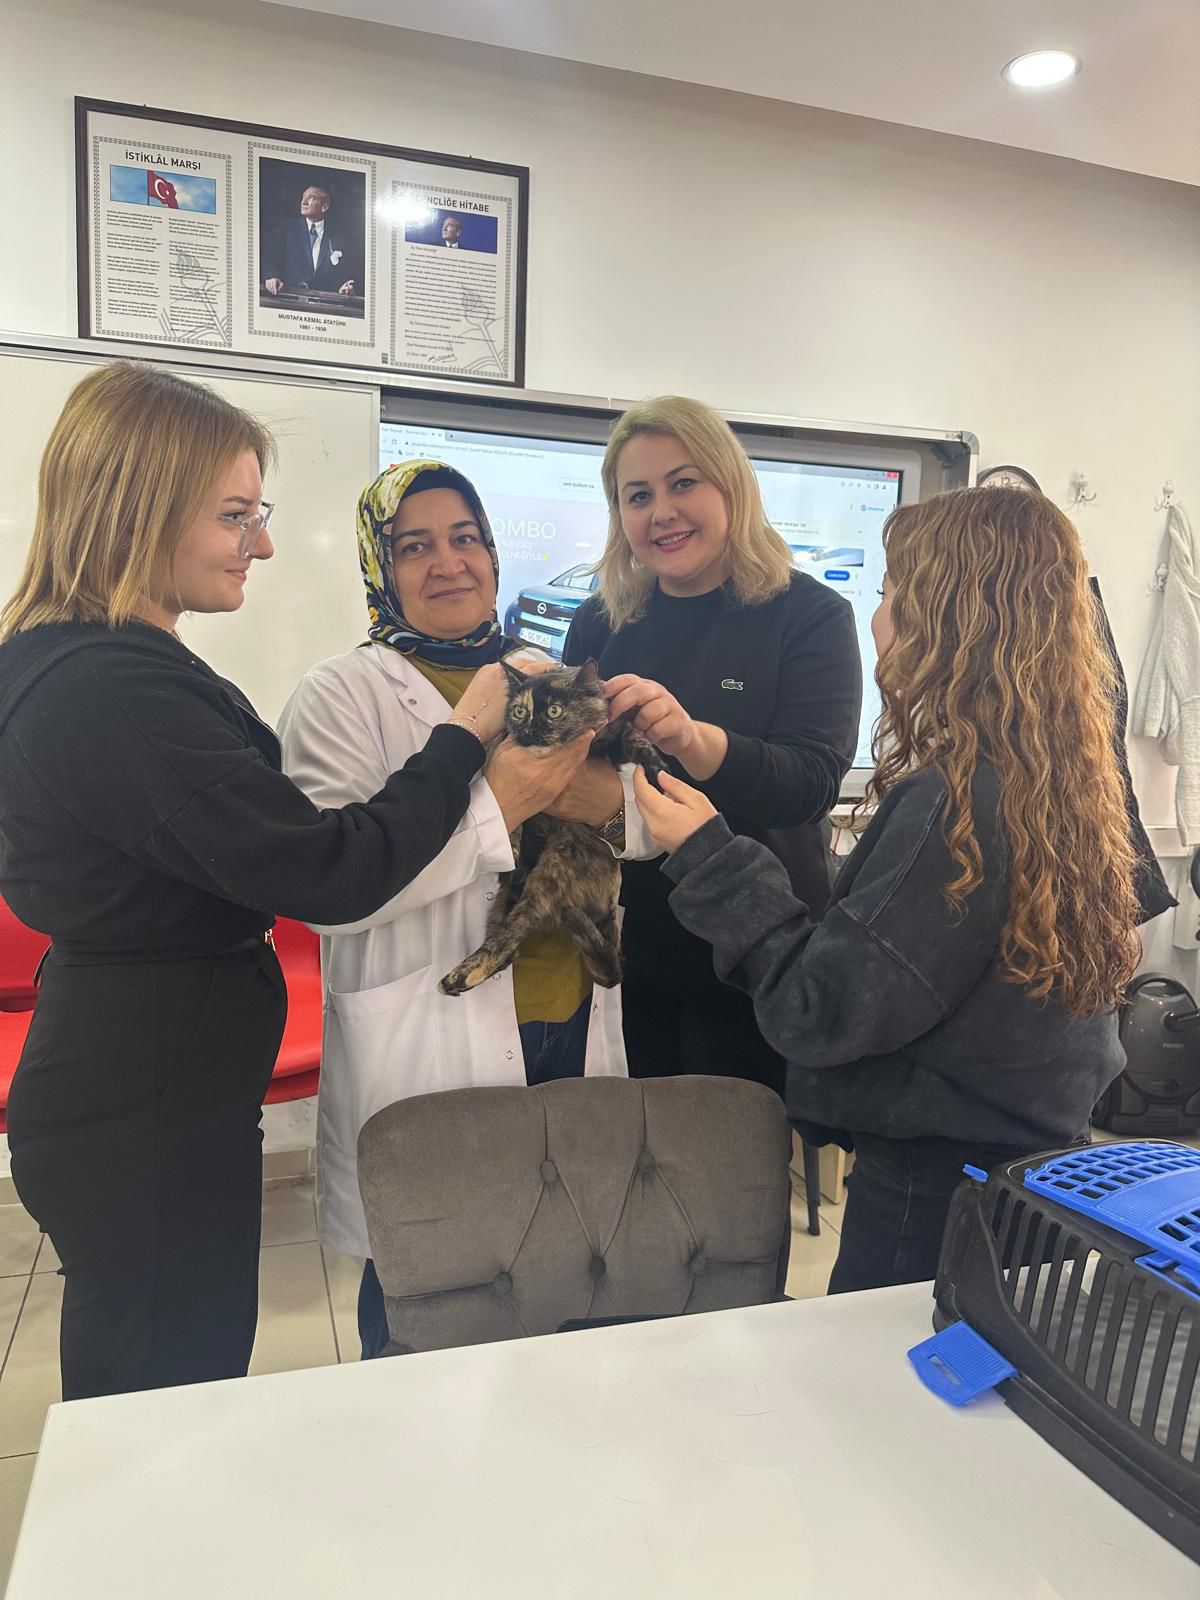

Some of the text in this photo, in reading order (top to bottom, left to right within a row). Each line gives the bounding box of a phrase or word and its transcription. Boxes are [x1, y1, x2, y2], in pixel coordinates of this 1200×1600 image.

[125, 149, 201, 170] İSTİKLÂL MARŞI
[459, 199, 490, 213] HİTABE
[278, 314, 346, 326] MUSTAFA KEMAL ATATÜRK
[492, 518, 556, 539] OMBO
